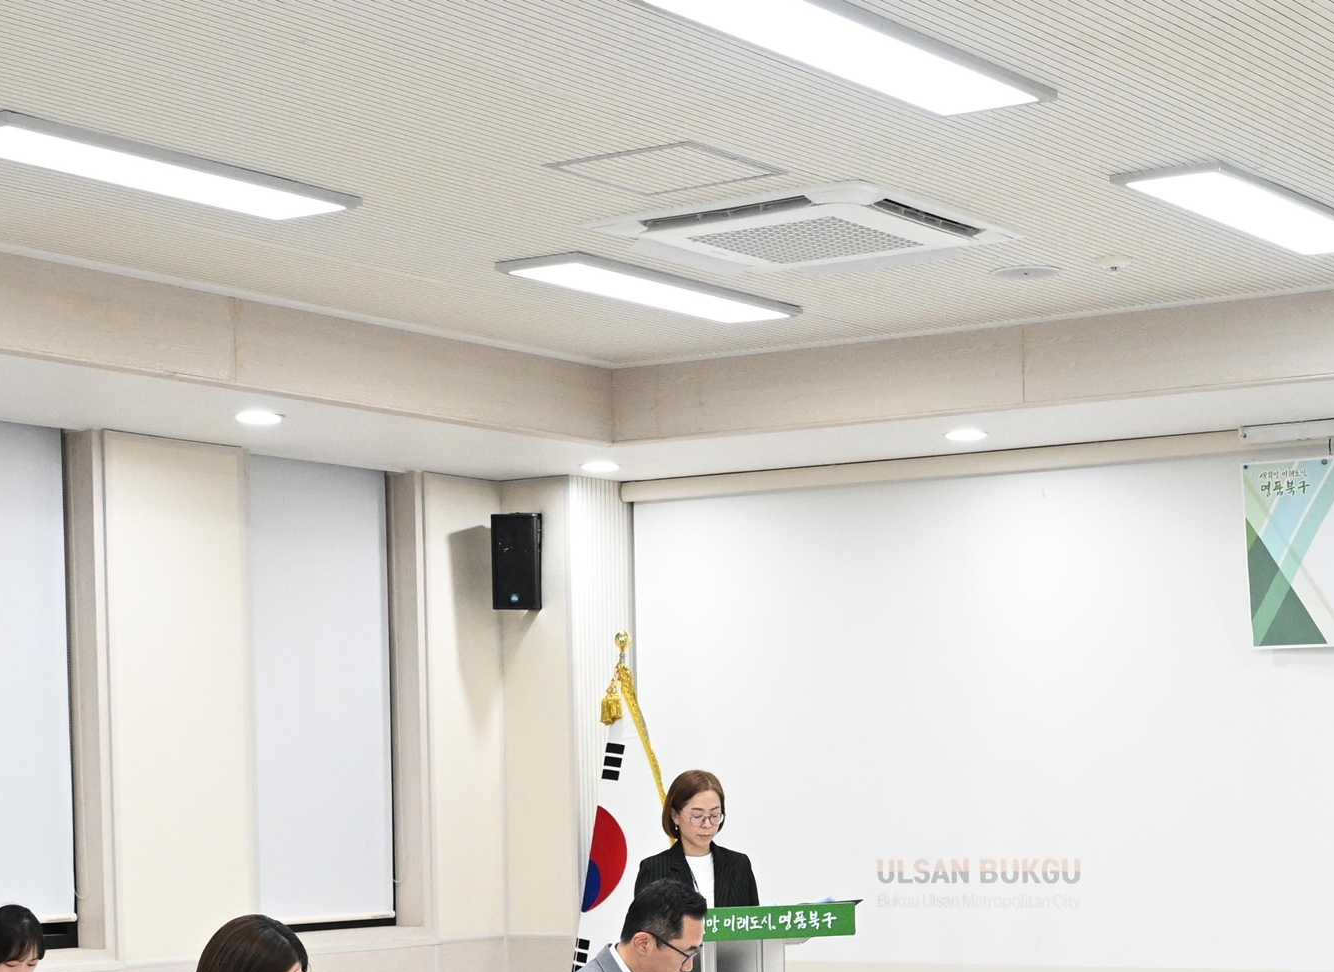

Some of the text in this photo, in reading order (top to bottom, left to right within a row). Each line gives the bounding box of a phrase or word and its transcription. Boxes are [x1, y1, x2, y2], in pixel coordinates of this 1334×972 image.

[1260, 480, 1311, 497] 명품북구
[876, 858, 1081, 885] ULSAN BUKGU
[877, 893, 1082, 910] Bukgu Ulsan Metropolitan City
[778, 910, 838, 931] 명품북구
